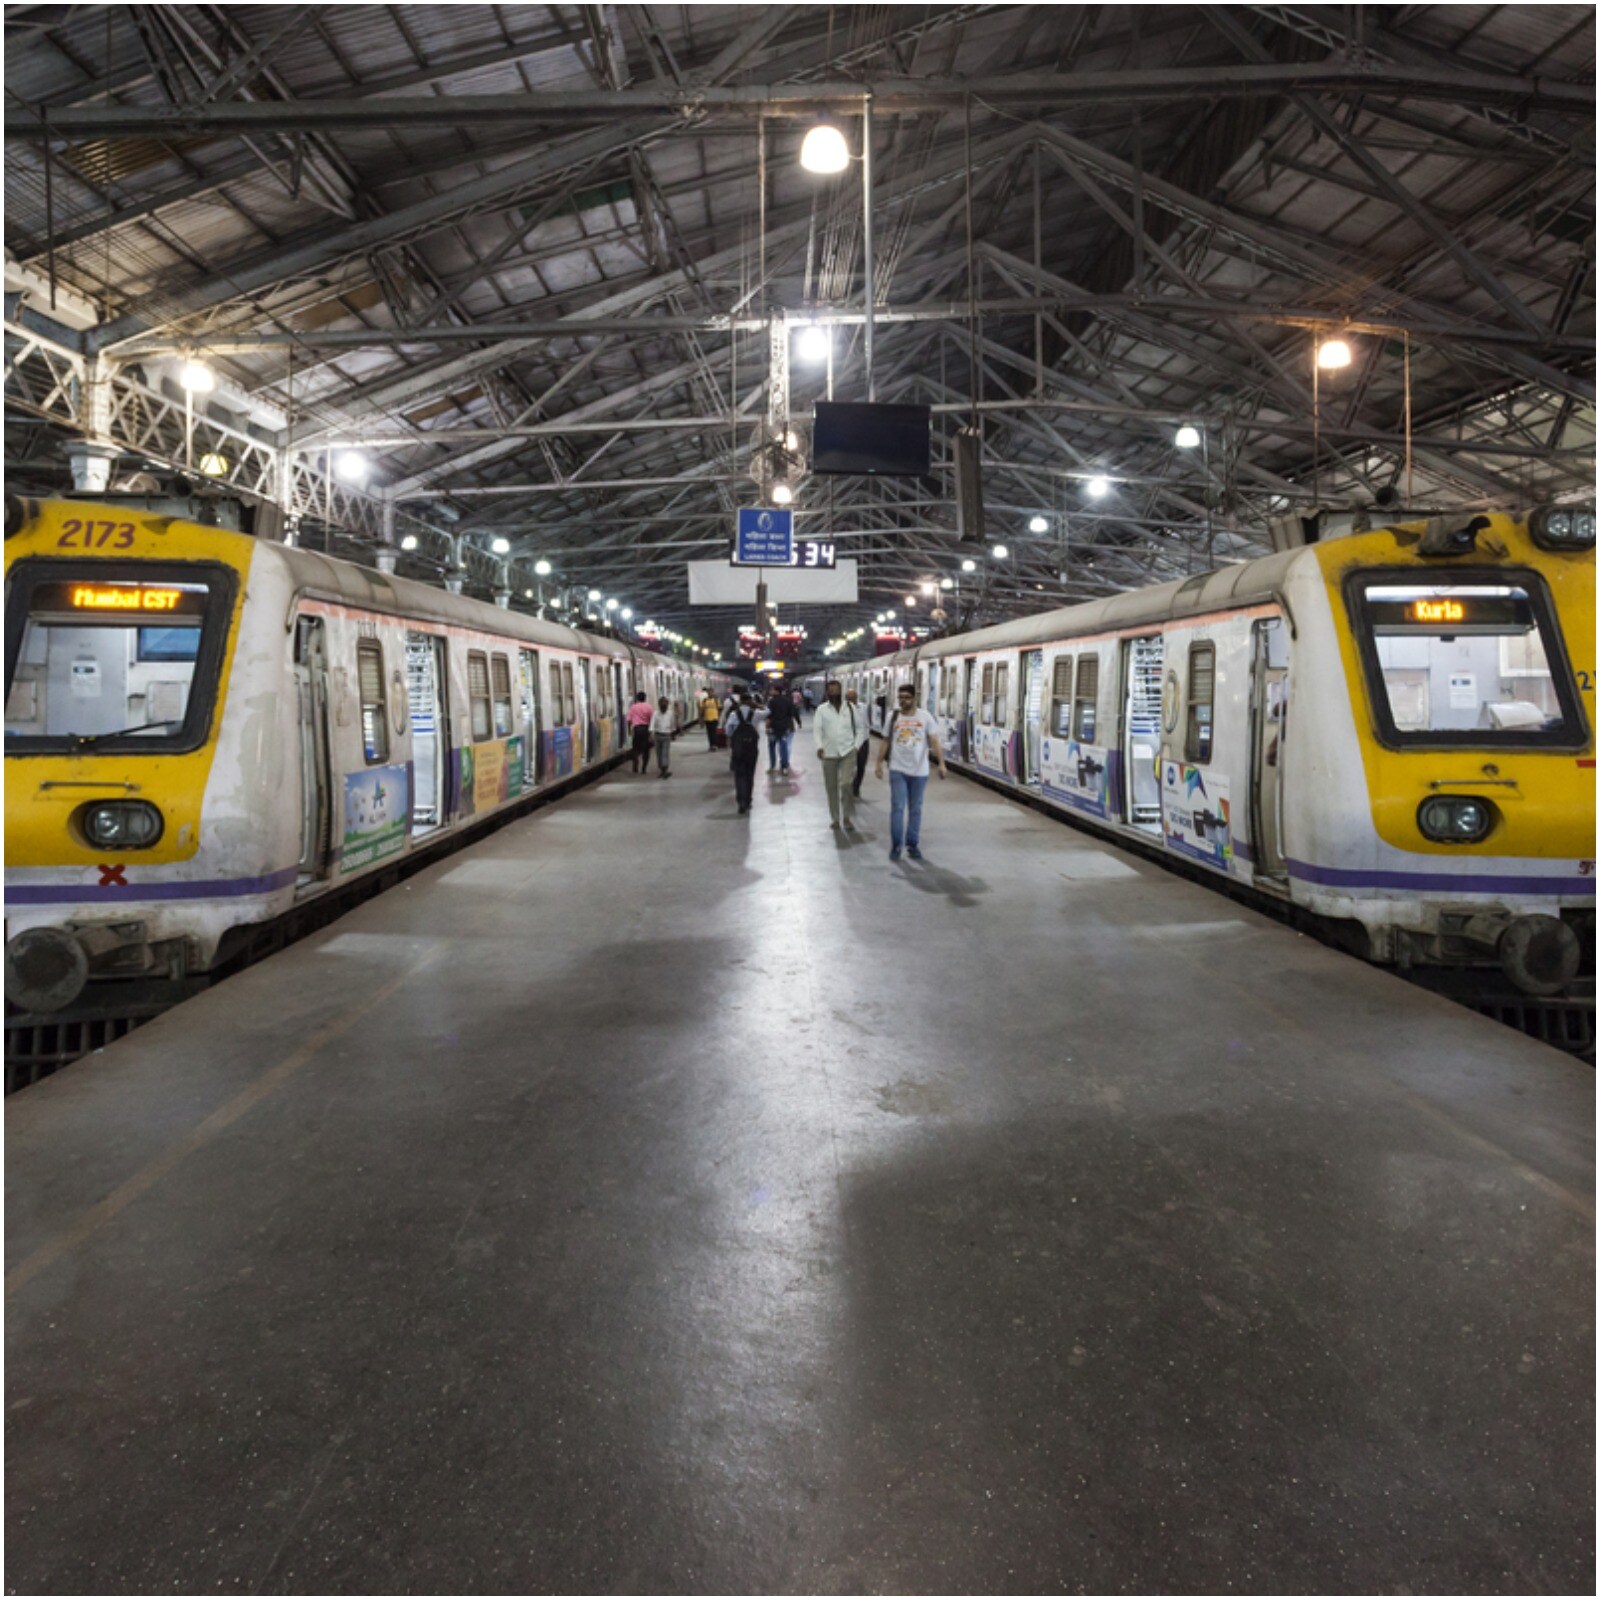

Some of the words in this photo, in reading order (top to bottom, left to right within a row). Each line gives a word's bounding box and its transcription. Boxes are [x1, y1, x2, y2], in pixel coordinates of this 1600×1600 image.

[57, 519, 136, 550] 2173
[73, 587, 141, 608] Mumbai
[143, 589, 180, 609] CST
[1415, 599, 1463, 618] Kurla
